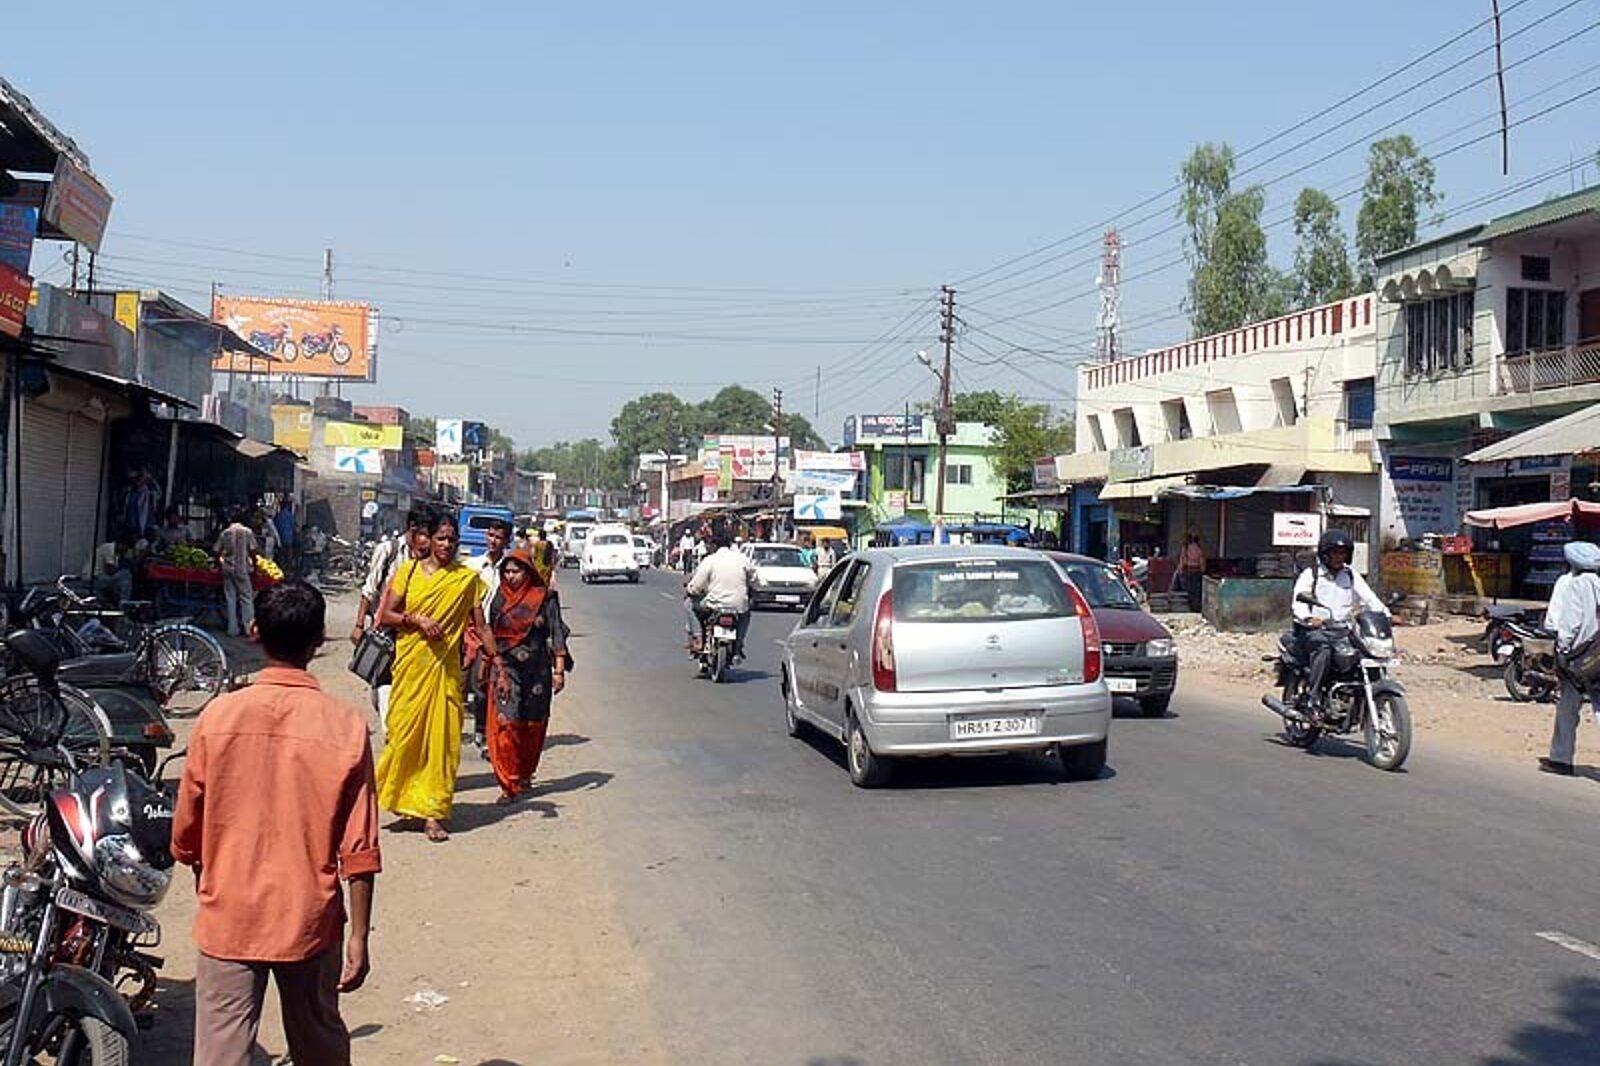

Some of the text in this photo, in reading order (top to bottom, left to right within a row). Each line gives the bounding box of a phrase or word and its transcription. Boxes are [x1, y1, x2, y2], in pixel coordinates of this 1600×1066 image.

[1410, 463, 1451, 477] PEPSI
[957, 721, 989, 735] HR51
[993, 720, 1002, 732] Z
